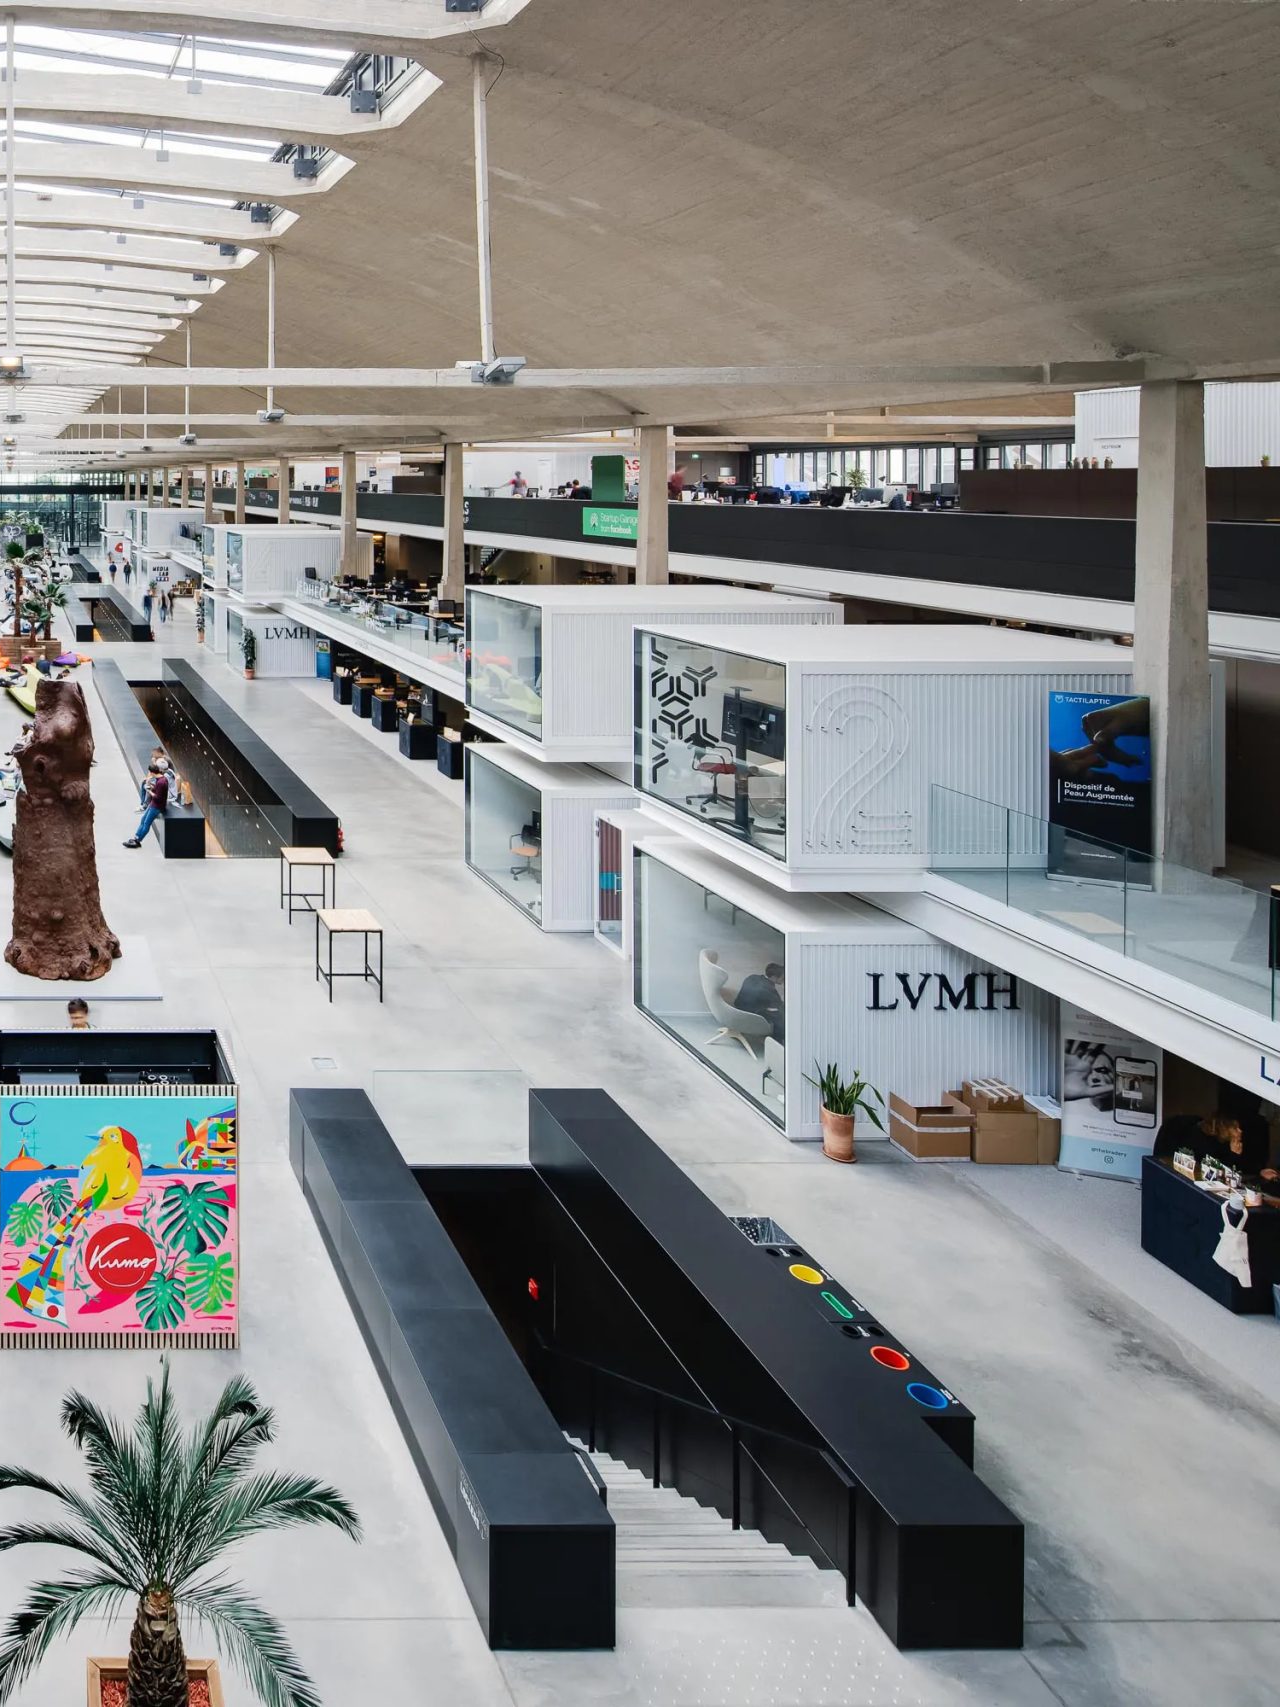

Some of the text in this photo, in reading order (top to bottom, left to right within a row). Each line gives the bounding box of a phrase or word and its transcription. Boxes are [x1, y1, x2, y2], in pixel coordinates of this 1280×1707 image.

[265, 626, 310, 640] LVMH
[1065, 696, 1111, 705] TACTILAPTIC
[1064, 781, 1102, 791] Dispositif
[1064, 788, 1135, 802] Peau Augmentée
[866, 971, 1021, 1011] LVMH
[89, 1236, 156, 1270] Kumo
